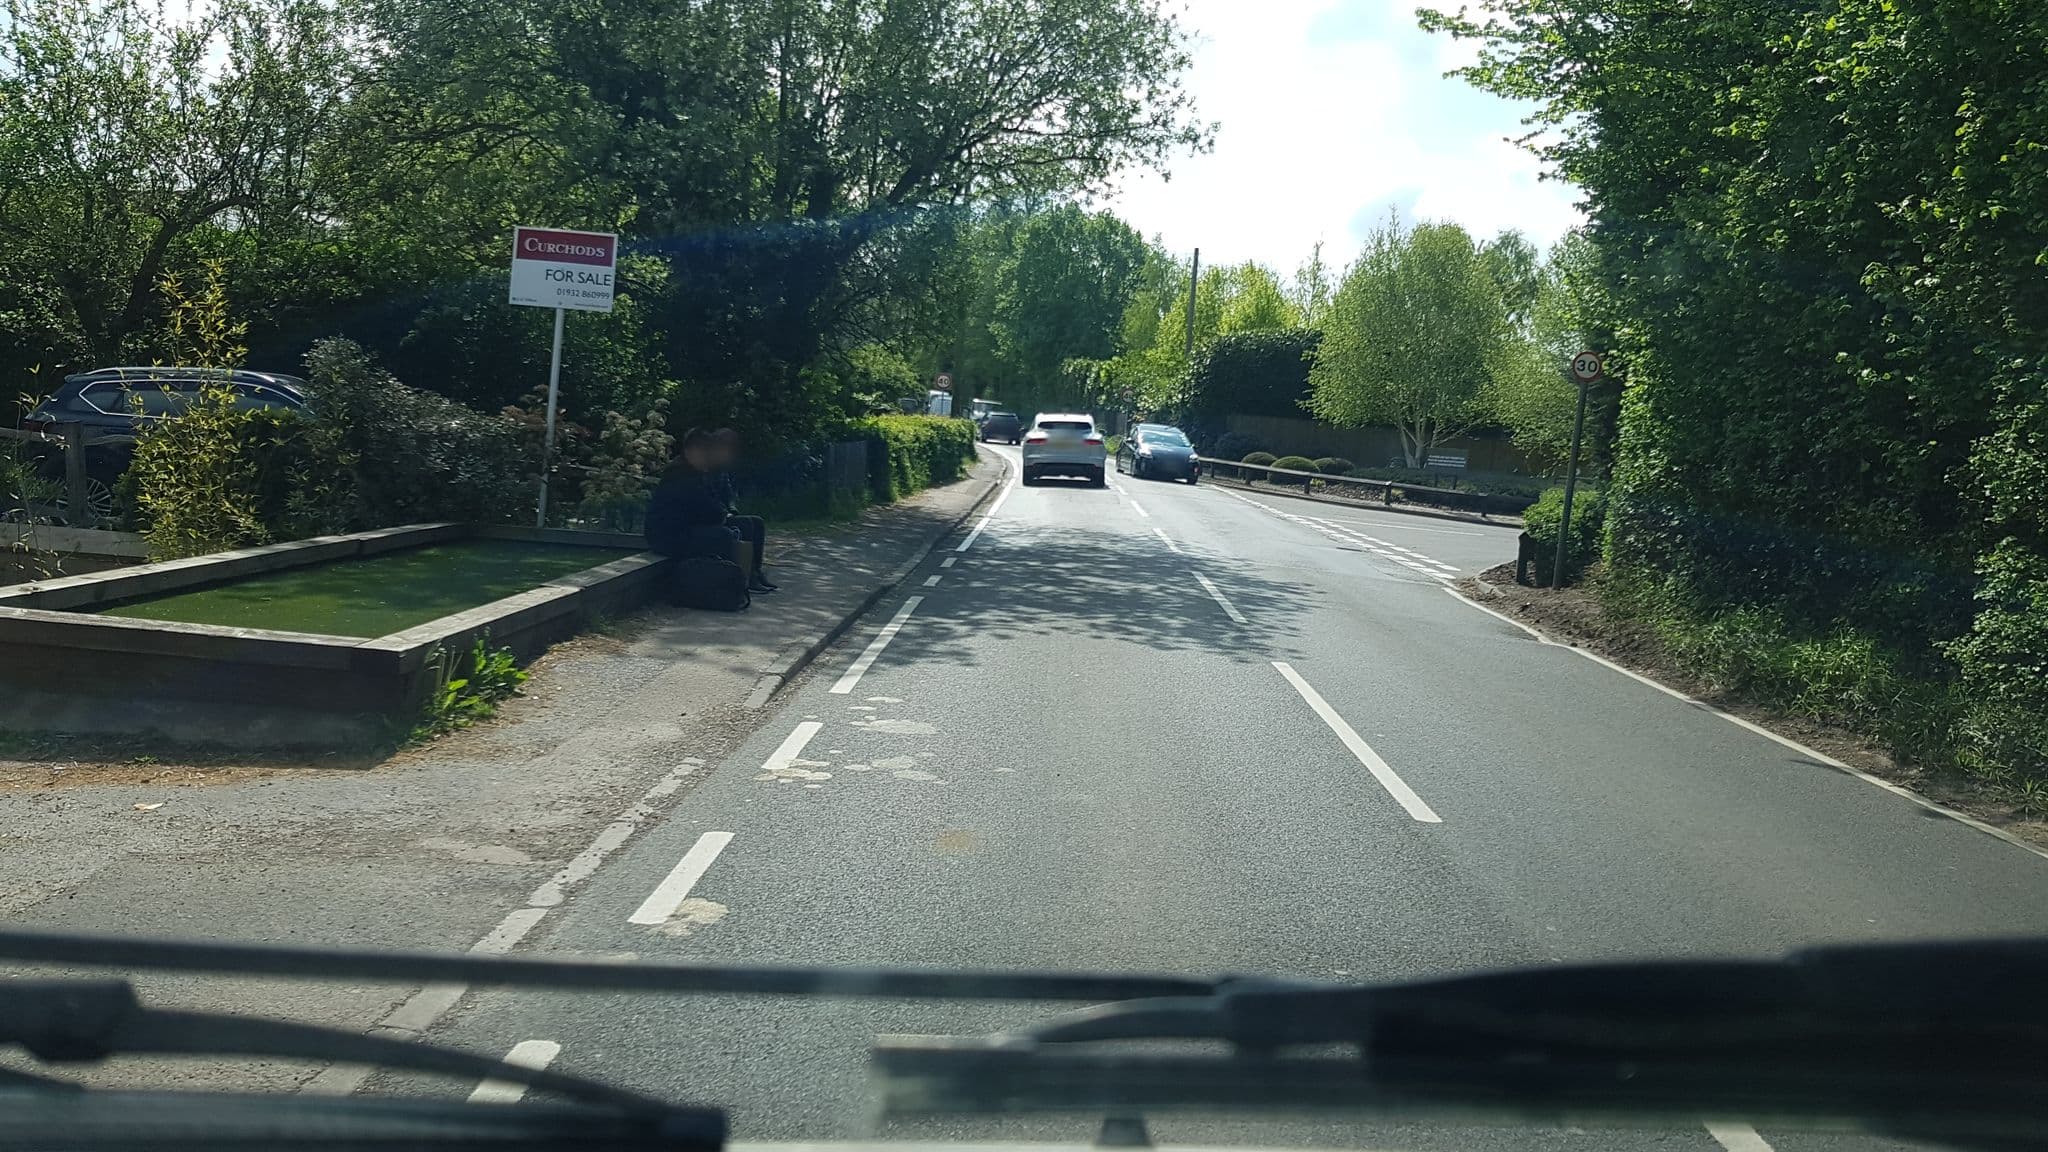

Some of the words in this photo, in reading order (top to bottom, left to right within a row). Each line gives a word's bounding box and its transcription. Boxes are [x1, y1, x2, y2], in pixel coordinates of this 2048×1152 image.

[524, 237, 606, 258] CURCHODS
[545, 269, 574, 283] FOR
[577, 271, 612, 287] SALE
[556, 288, 580, 298] 01932
[1576, 359, 1598, 373] 30
[938, 377, 950, 386] 40
